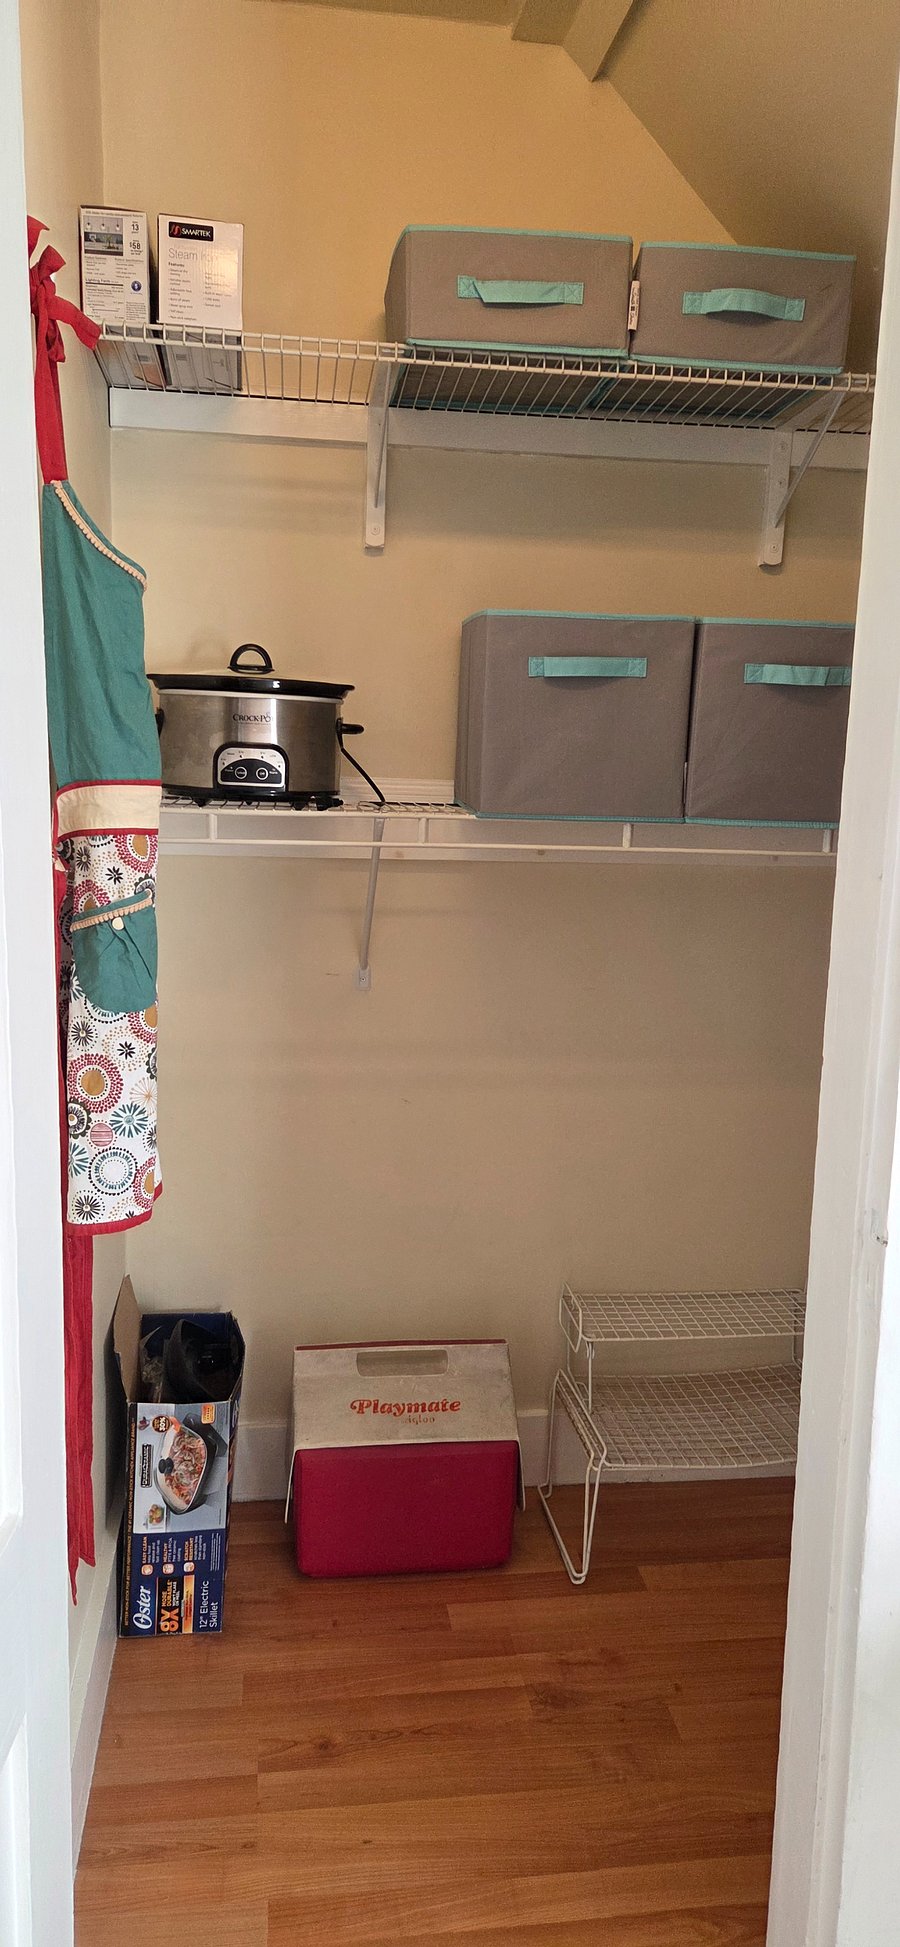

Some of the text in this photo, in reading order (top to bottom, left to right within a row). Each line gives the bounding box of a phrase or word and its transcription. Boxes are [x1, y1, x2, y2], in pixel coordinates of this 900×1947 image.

[131, 223, 139, 231] 13
[181, 227, 211, 238] SMARTEK
[129, 241, 141, 250] $58
[168, 247, 198, 260] Steam
[350, 1398, 461, 1417] Playmate
[200, 1580, 209, 1614] Electric
[132, 1585, 153, 1629] Oster
[209, 1601, 218, 1628] Skillet
[160, 1608, 179, 1632] 8X
